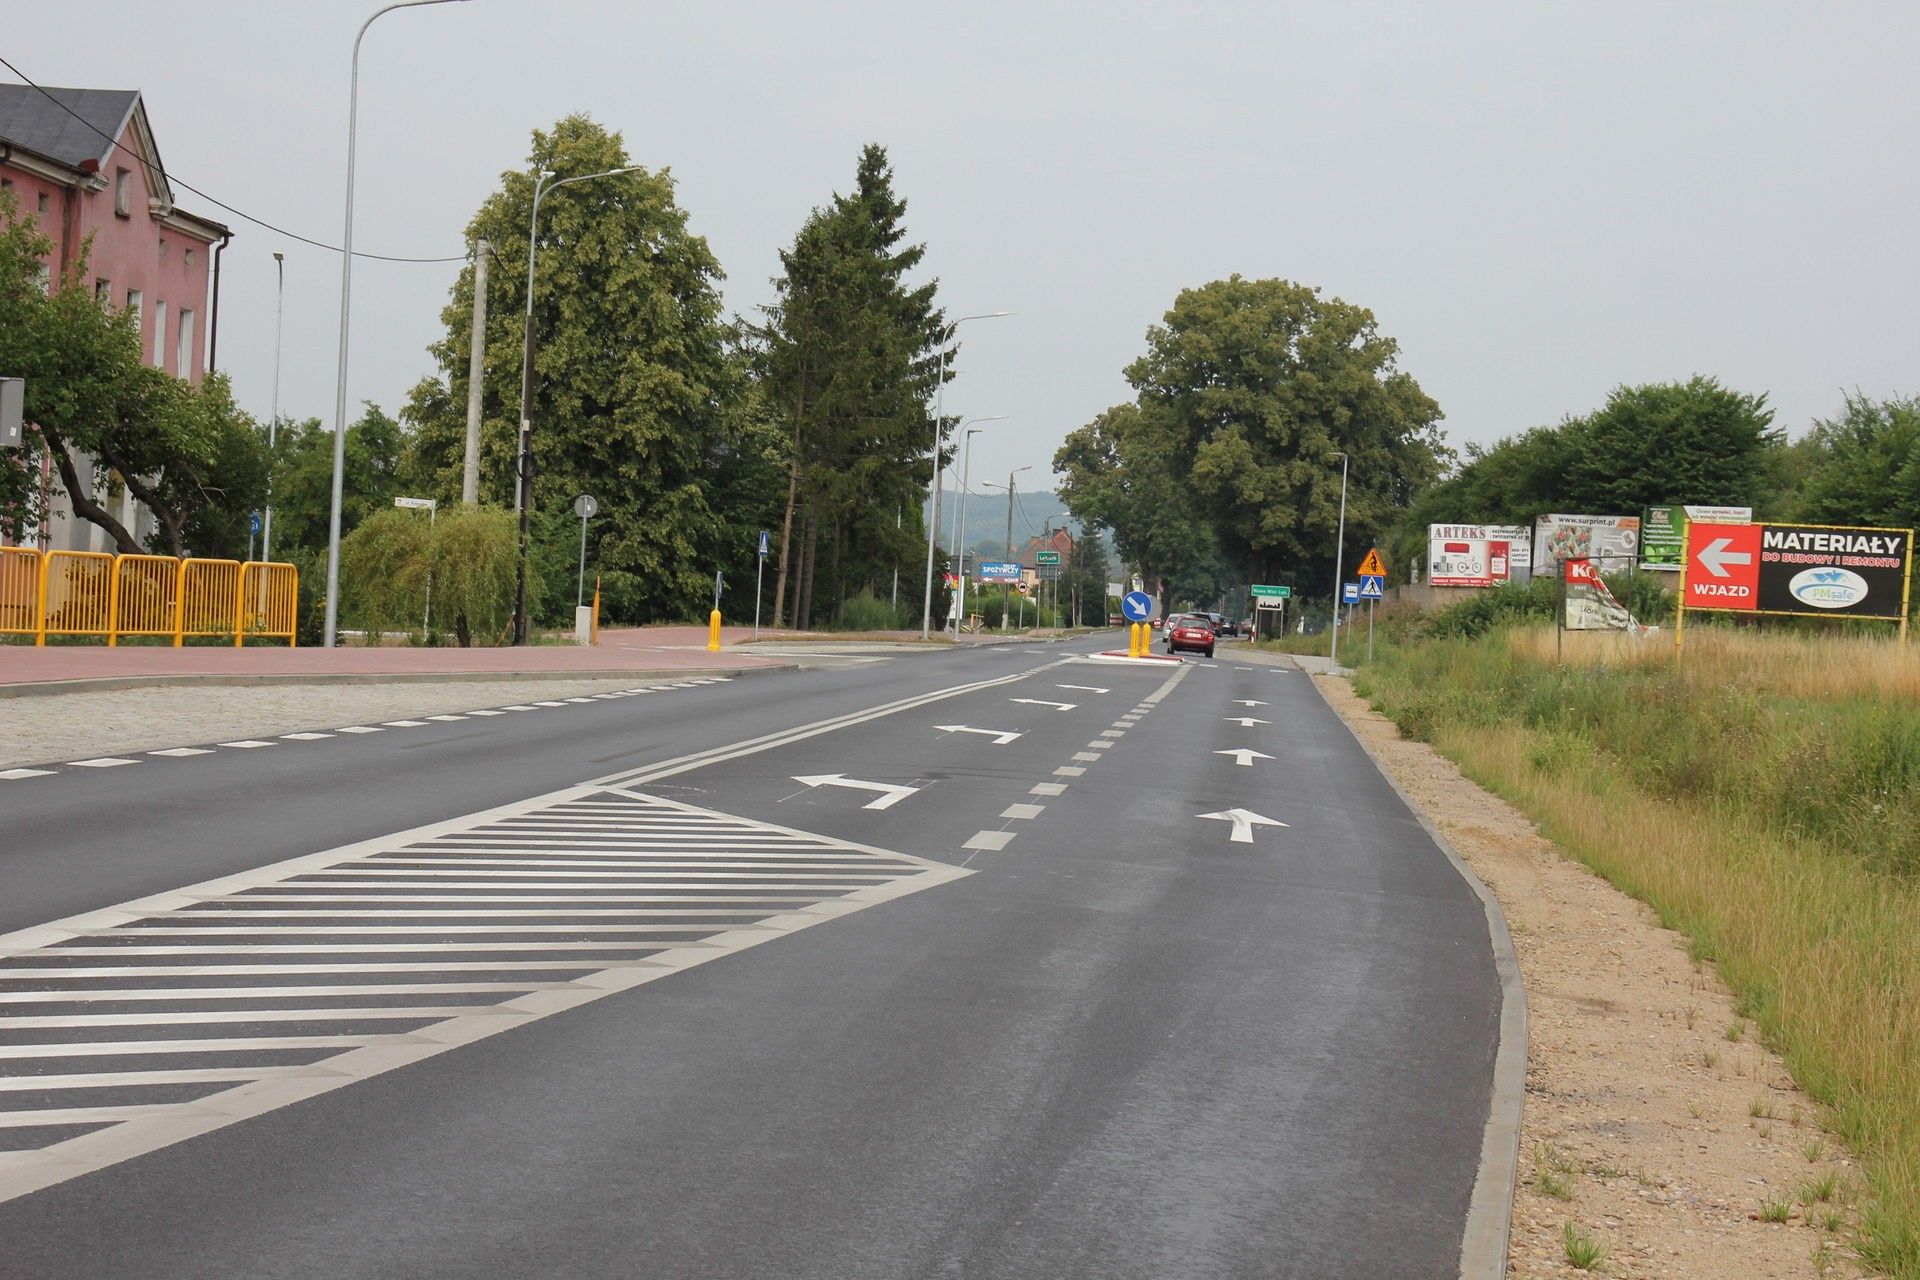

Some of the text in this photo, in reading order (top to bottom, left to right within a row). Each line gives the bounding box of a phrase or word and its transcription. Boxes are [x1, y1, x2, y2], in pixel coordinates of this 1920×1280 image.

[1558, 517, 1616, 526] www.surprint.pl
[1434, 527, 1487, 540] ARTEKS
[1763, 531, 1901, 555] MATERIAŁY
[1762, 551, 1901, 569] DO BUDOWY I REMONTU
[982, 566, 1019, 574] SPOŻYWCZY
[1693, 583, 1751, 598] WJAZD
